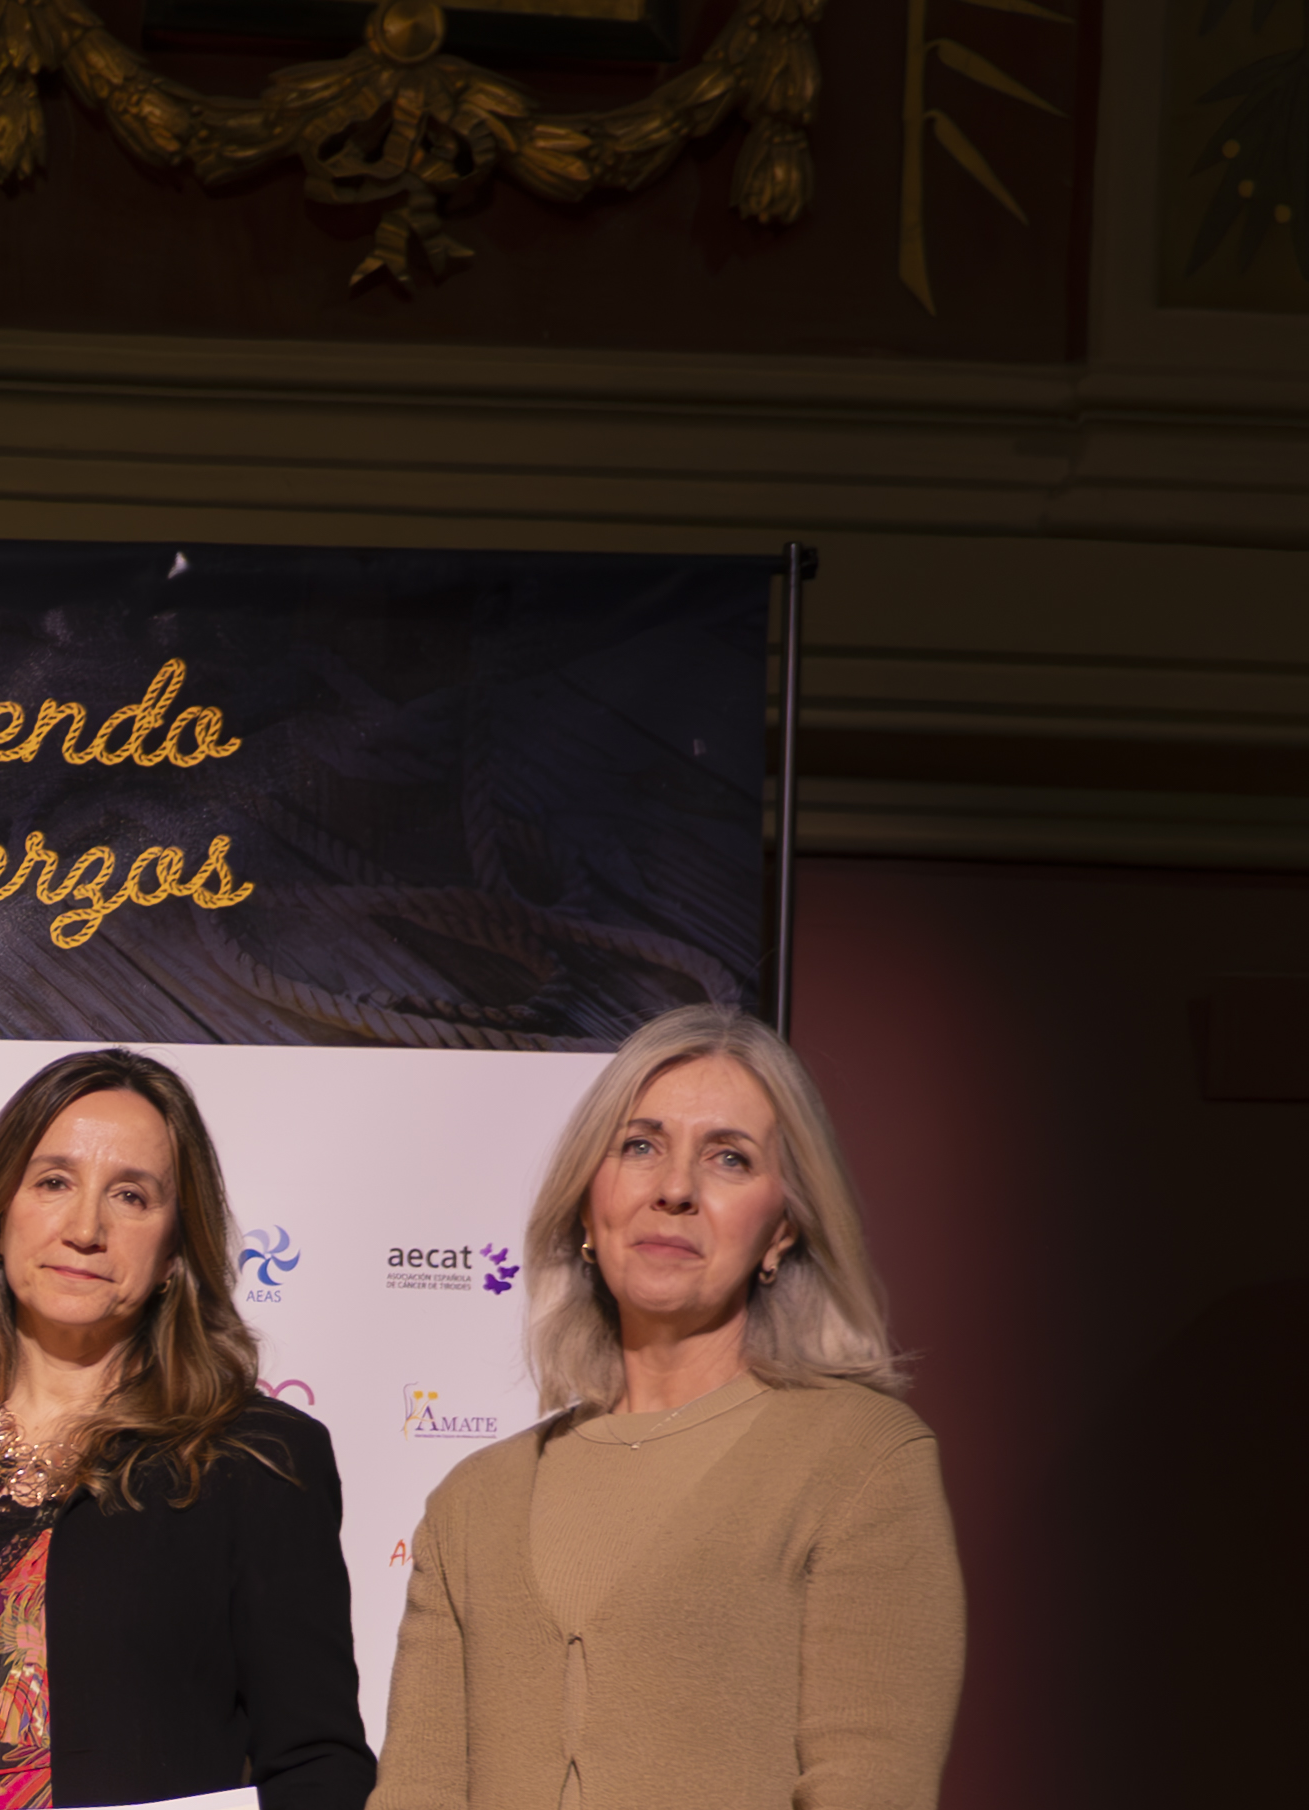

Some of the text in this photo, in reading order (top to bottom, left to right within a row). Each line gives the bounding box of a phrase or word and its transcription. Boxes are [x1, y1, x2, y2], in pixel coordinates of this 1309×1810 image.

[387, 1245, 473, 1270] aecat
[246, 1289, 282, 1303] AEAS
[414, 1404, 498, 1433] AMATE
